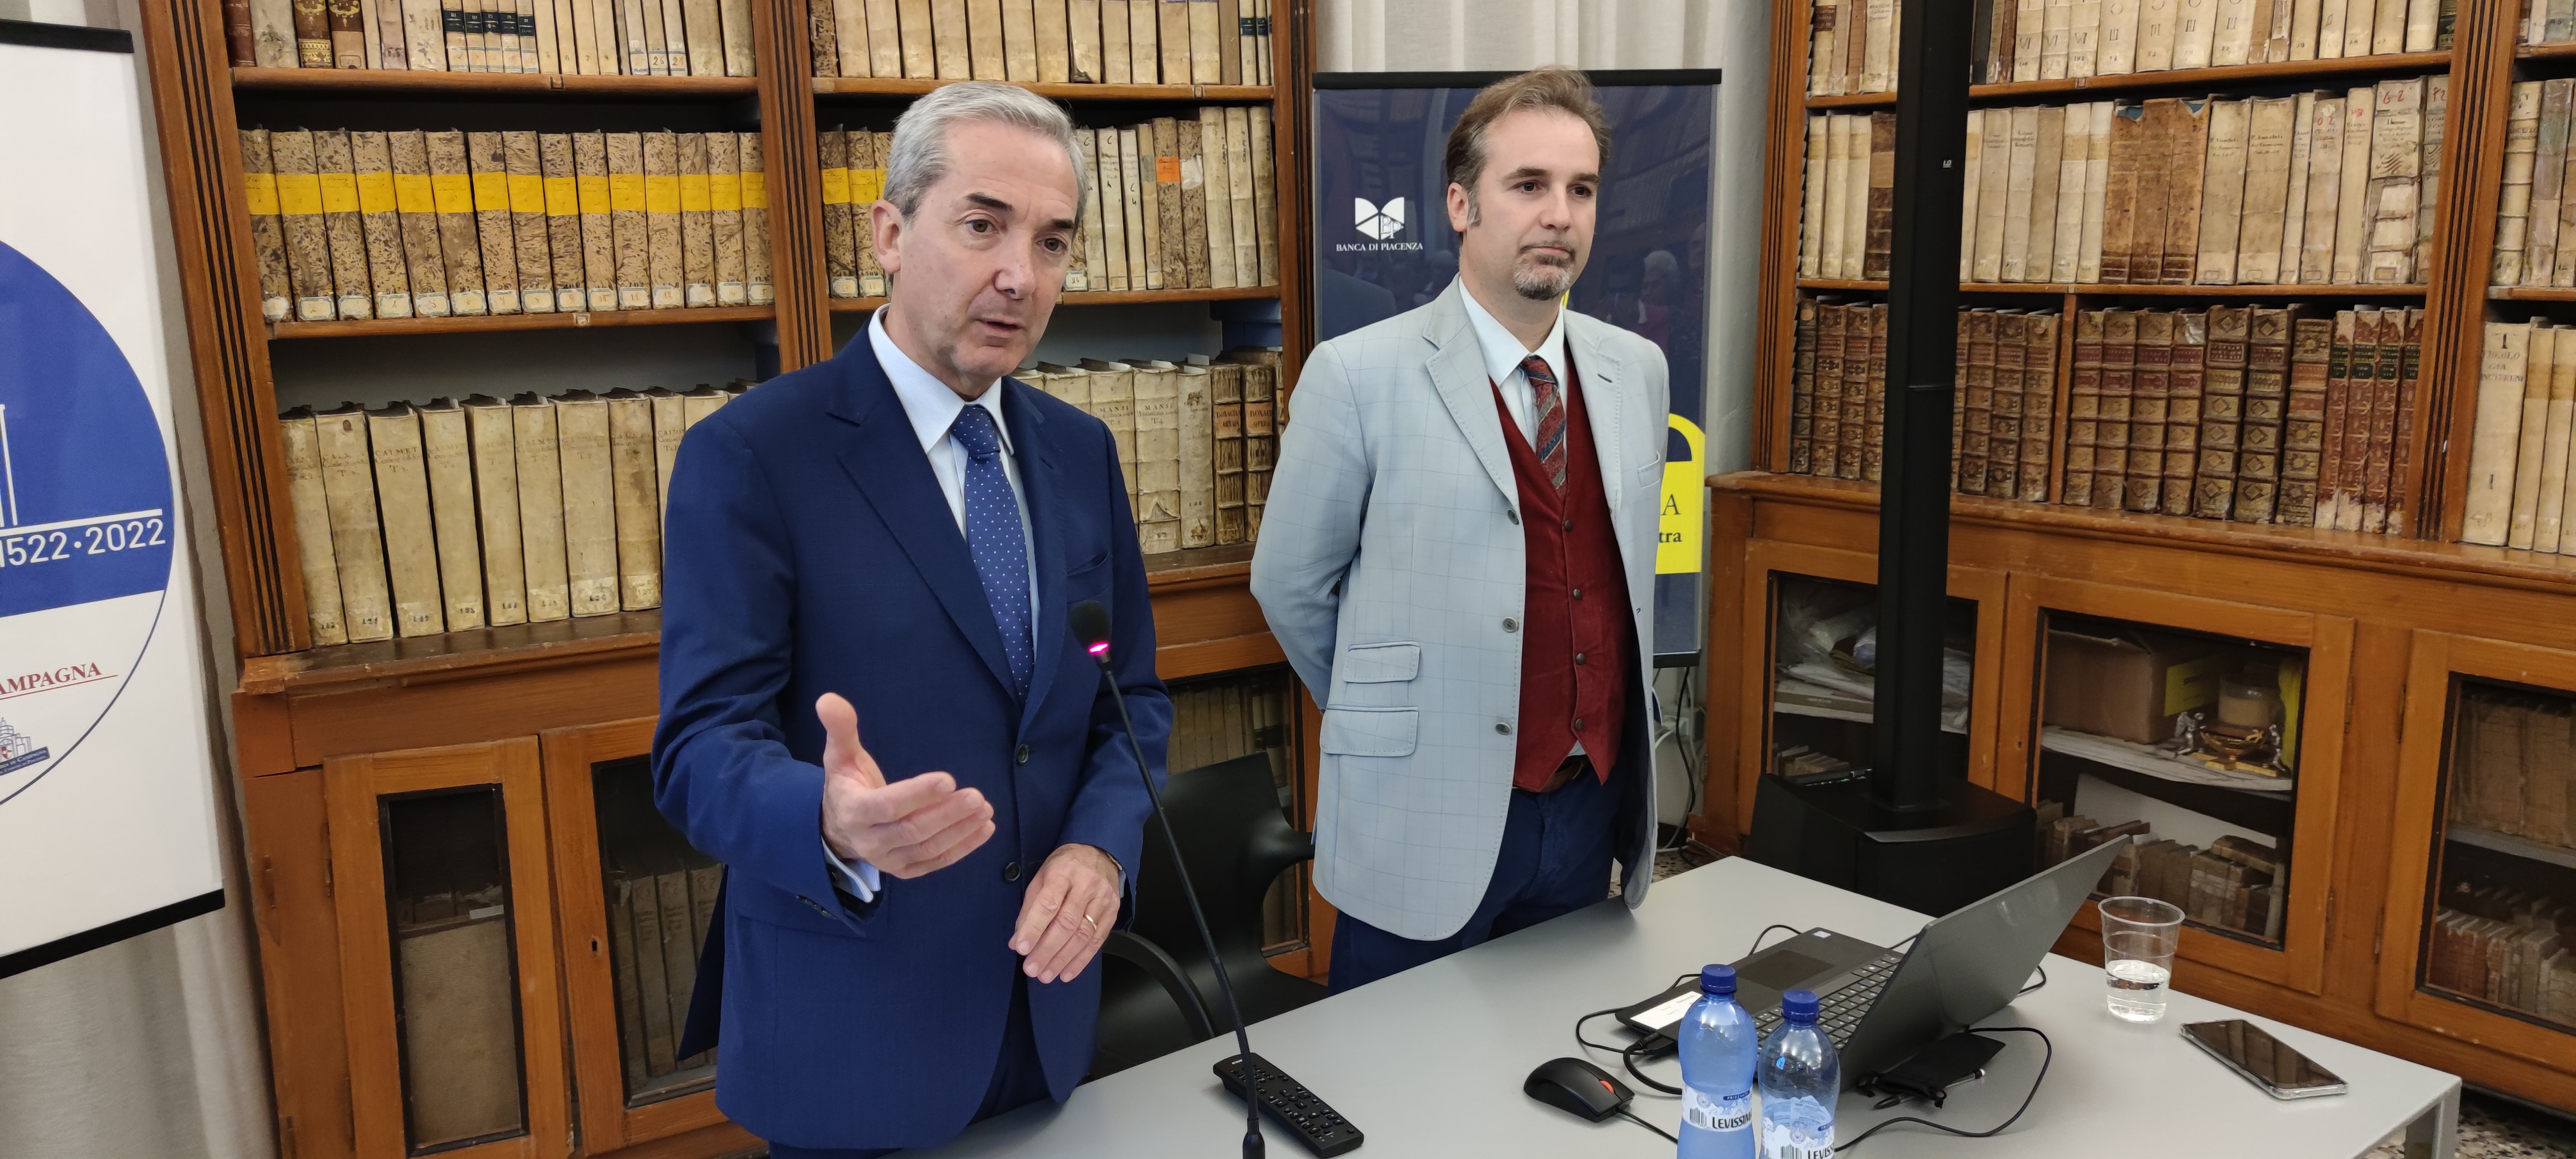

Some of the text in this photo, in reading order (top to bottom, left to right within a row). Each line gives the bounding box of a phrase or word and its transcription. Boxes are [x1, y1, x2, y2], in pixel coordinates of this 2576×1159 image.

[1336, 244, 1366, 252] BANCA
[1381, 242, 1423, 251] PIACENZA
[1712, 1107, 1752, 1129] LEVISSIM
